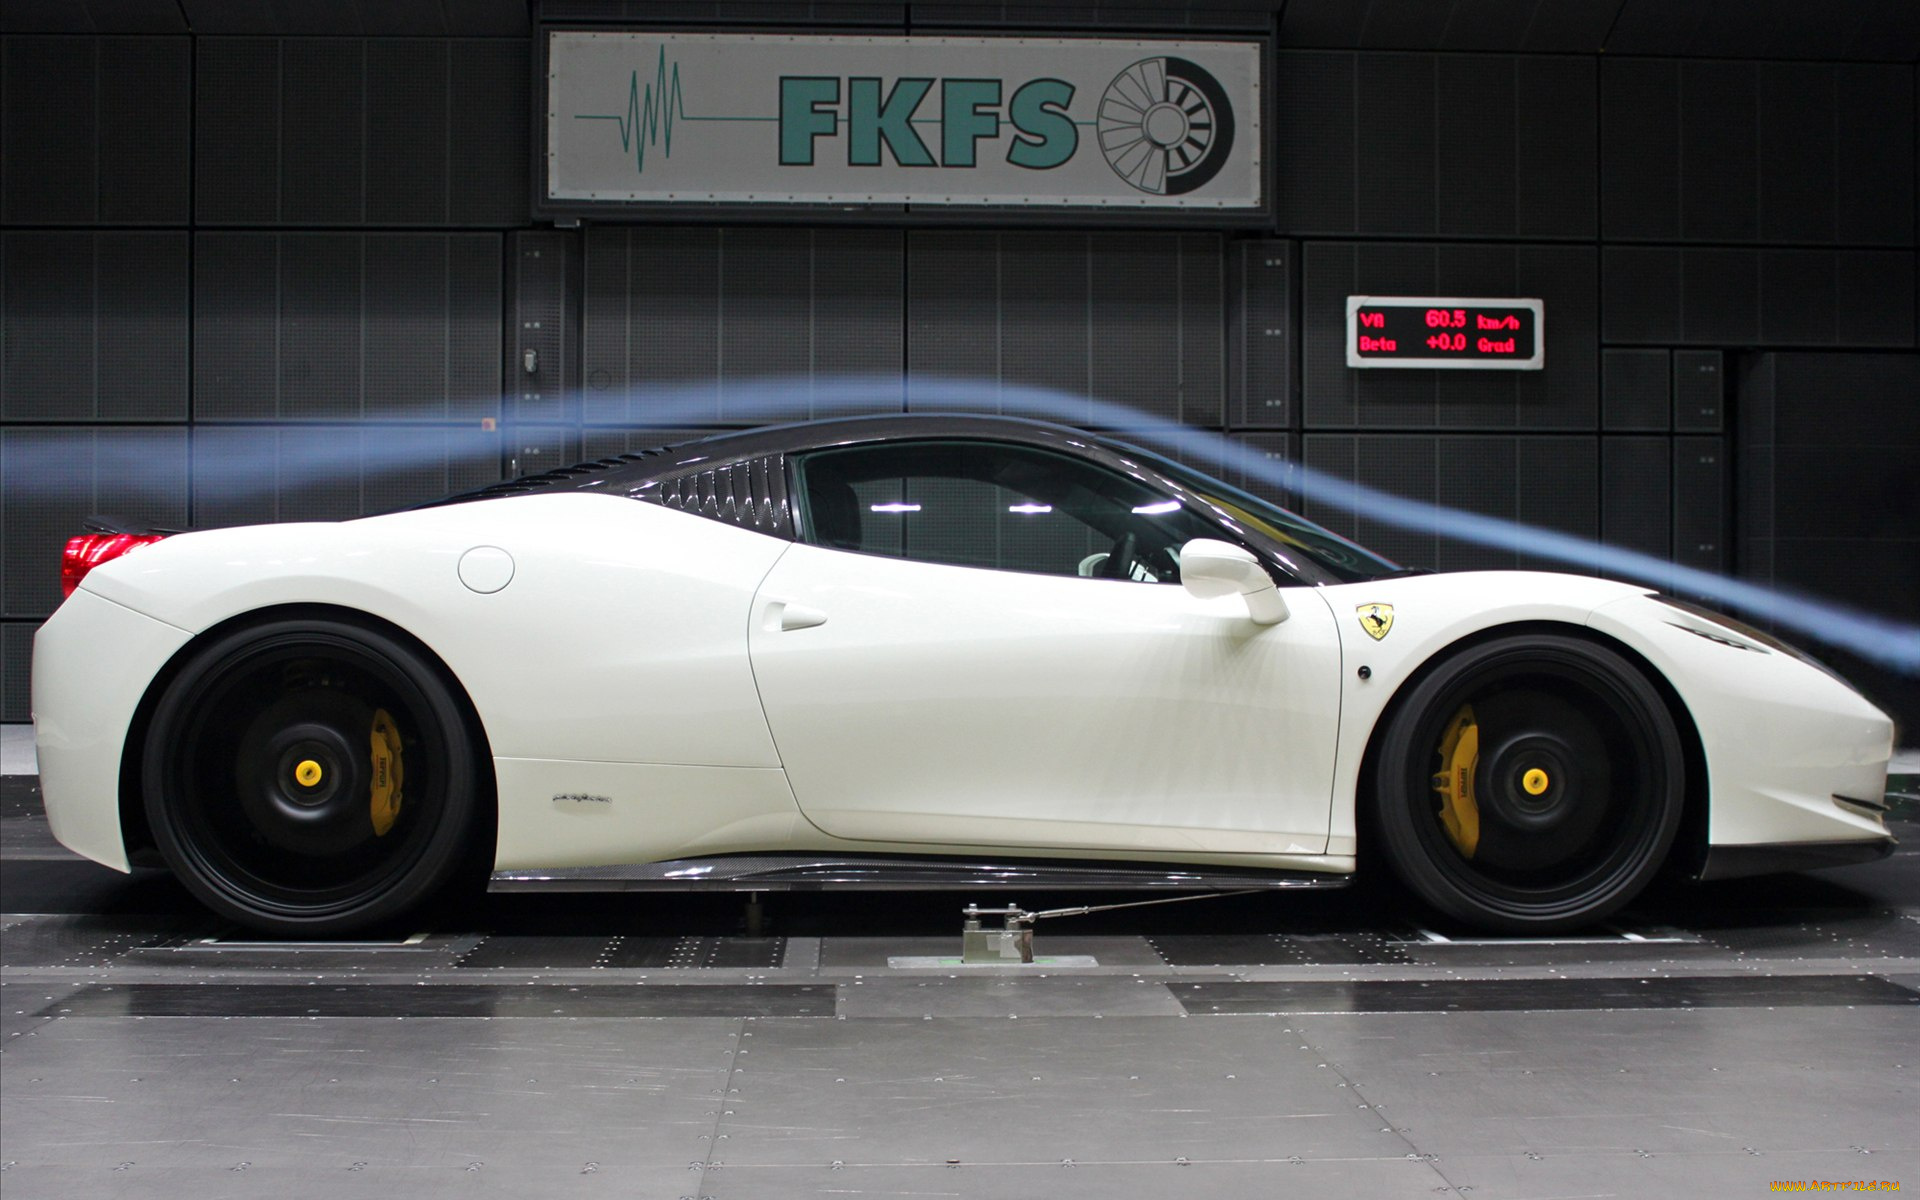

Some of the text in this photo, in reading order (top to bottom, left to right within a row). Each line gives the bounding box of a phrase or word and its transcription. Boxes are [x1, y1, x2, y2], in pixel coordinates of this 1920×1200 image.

[779, 76, 1079, 170] FKFS
[1360, 309, 1520, 330] VA 60.5 km/h
[1359, 332, 1515, 353] Beta +0.0 Grad
